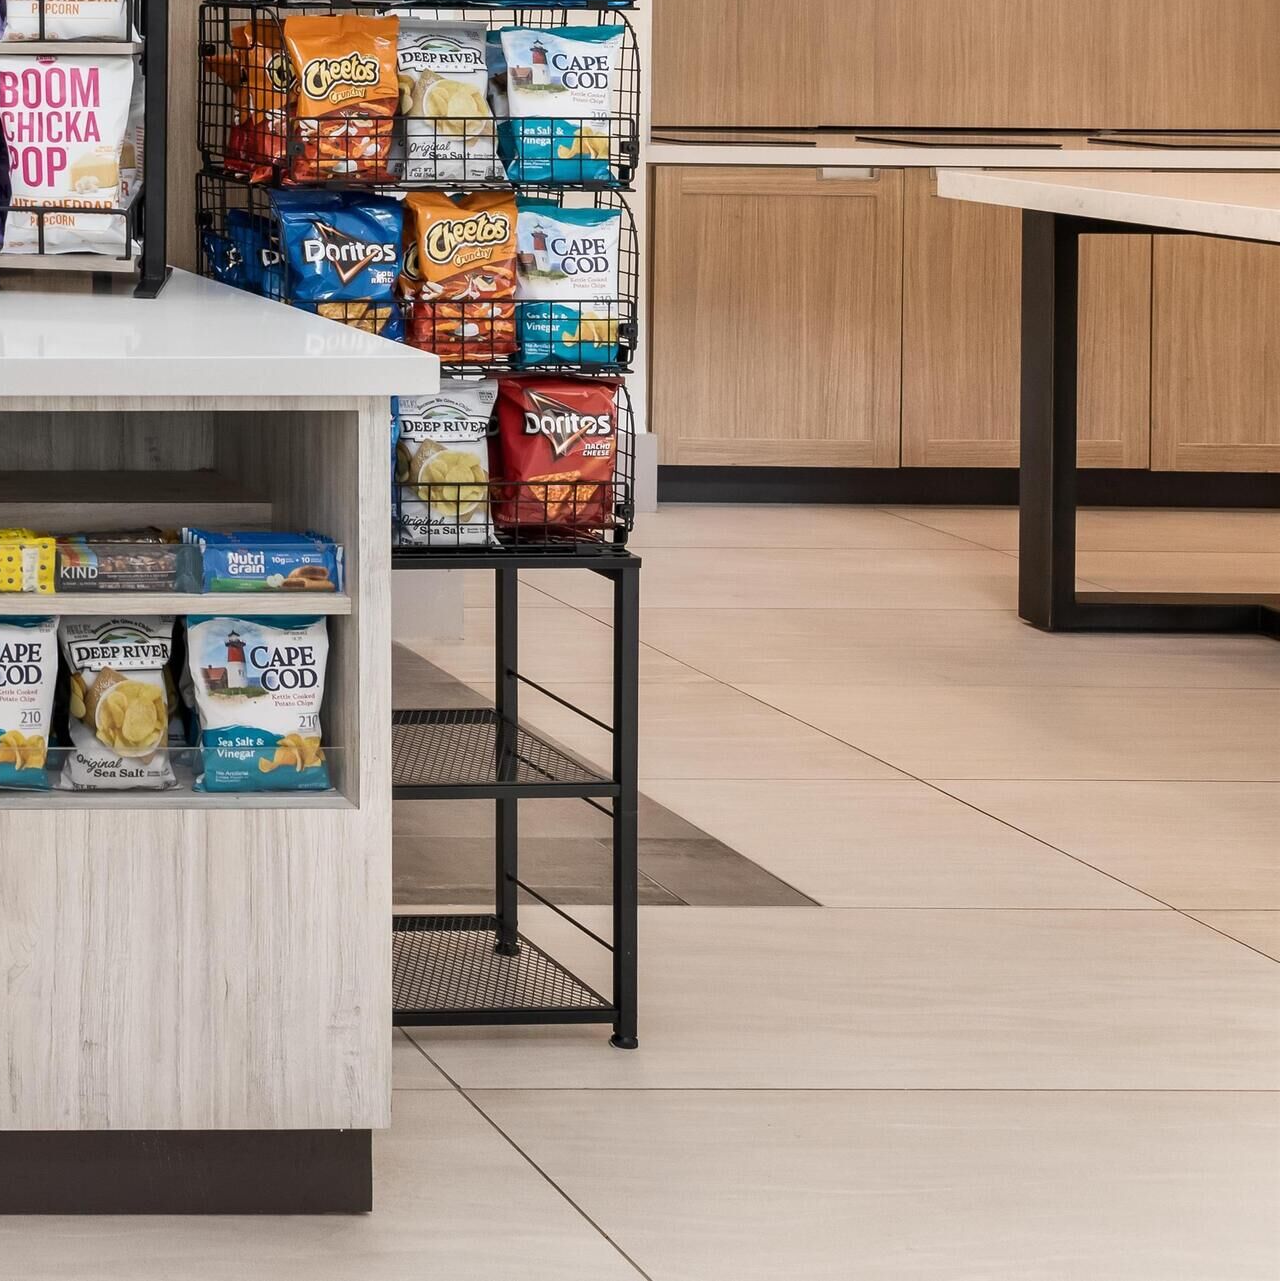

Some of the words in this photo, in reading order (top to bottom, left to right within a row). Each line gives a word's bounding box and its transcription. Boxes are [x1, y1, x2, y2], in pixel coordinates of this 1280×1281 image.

[31, 3, 80, 16] PPCORN
[401, 52, 437, 64] DEEP
[440, 52, 484, 65] RIVER
[552, 54, 609, 71] CAPE
[304, 53, 378, 98] Cheetos
[562, 72, 608, 89] COD
[0, 68, 100, 109] BOOM
[329, 87, 366, 103] Crunchy
[2, 111, 101, 143] CHICKA
[9, 147, 67, 188] POP
[425, 211, 510, 264] Cheetos
[304, 239, 396, 263] Doritos
[551, 239, 606, 256] CAPE
[454, 248, 493, 267] Crunchy
[561, 257, 609, 275] COD
[403, 420, 441, 433] DEEP
[525, 412, 611, 435] Doritos
[228, 551, 265, 565] Nutri
[272, 556, 285, 565] 10g
[60, 566, 98, 579] KIND
[228, 564, 265, 575] Grain
[77, 646, 121, 661] DEEP
[124, 644, 170, 659] RIVER
[250, 646, 316, 669] CAPE
[261, 668, 318, 691] COD
[21, 711, 41, 724] 210
[217, 737, 233, 747] Sea
[235, 738, 253, 747] Salt
[217, 748, 256, 760] Vinegar
[77, 754, 122, 773] Original
[94, 769, 117, 777] Sea
[119, 769, 144, 777] Salt
